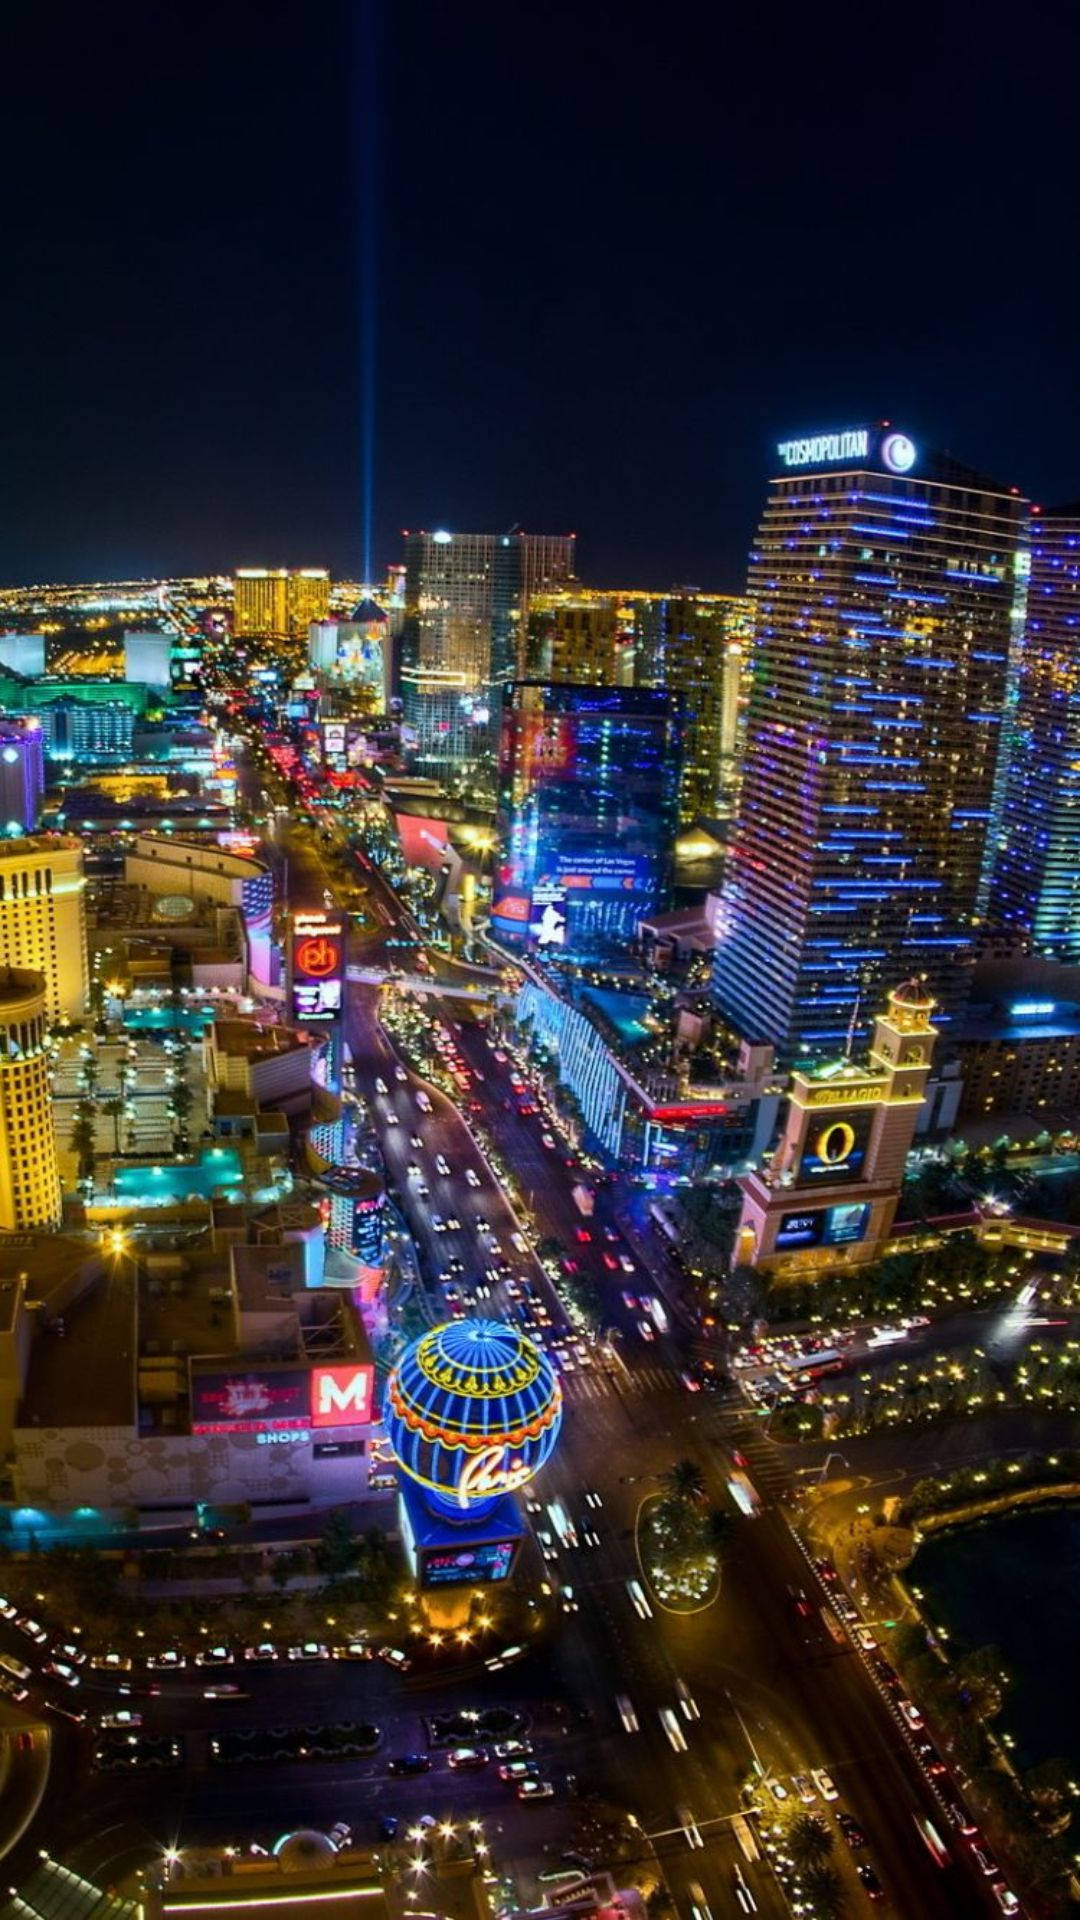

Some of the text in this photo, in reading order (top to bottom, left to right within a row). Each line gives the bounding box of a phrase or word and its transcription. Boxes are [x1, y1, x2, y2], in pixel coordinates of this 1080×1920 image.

[785, 430, 869, 466] COSMOPOLITAN
[604, 857, 615, 865] Las
[817, 1121, 855, 1165] O
[318, 1371, 368, 1414] M
[256, 1430, 309, 1445] SHOPS
[458, 1445, 531, 1509] Paris
